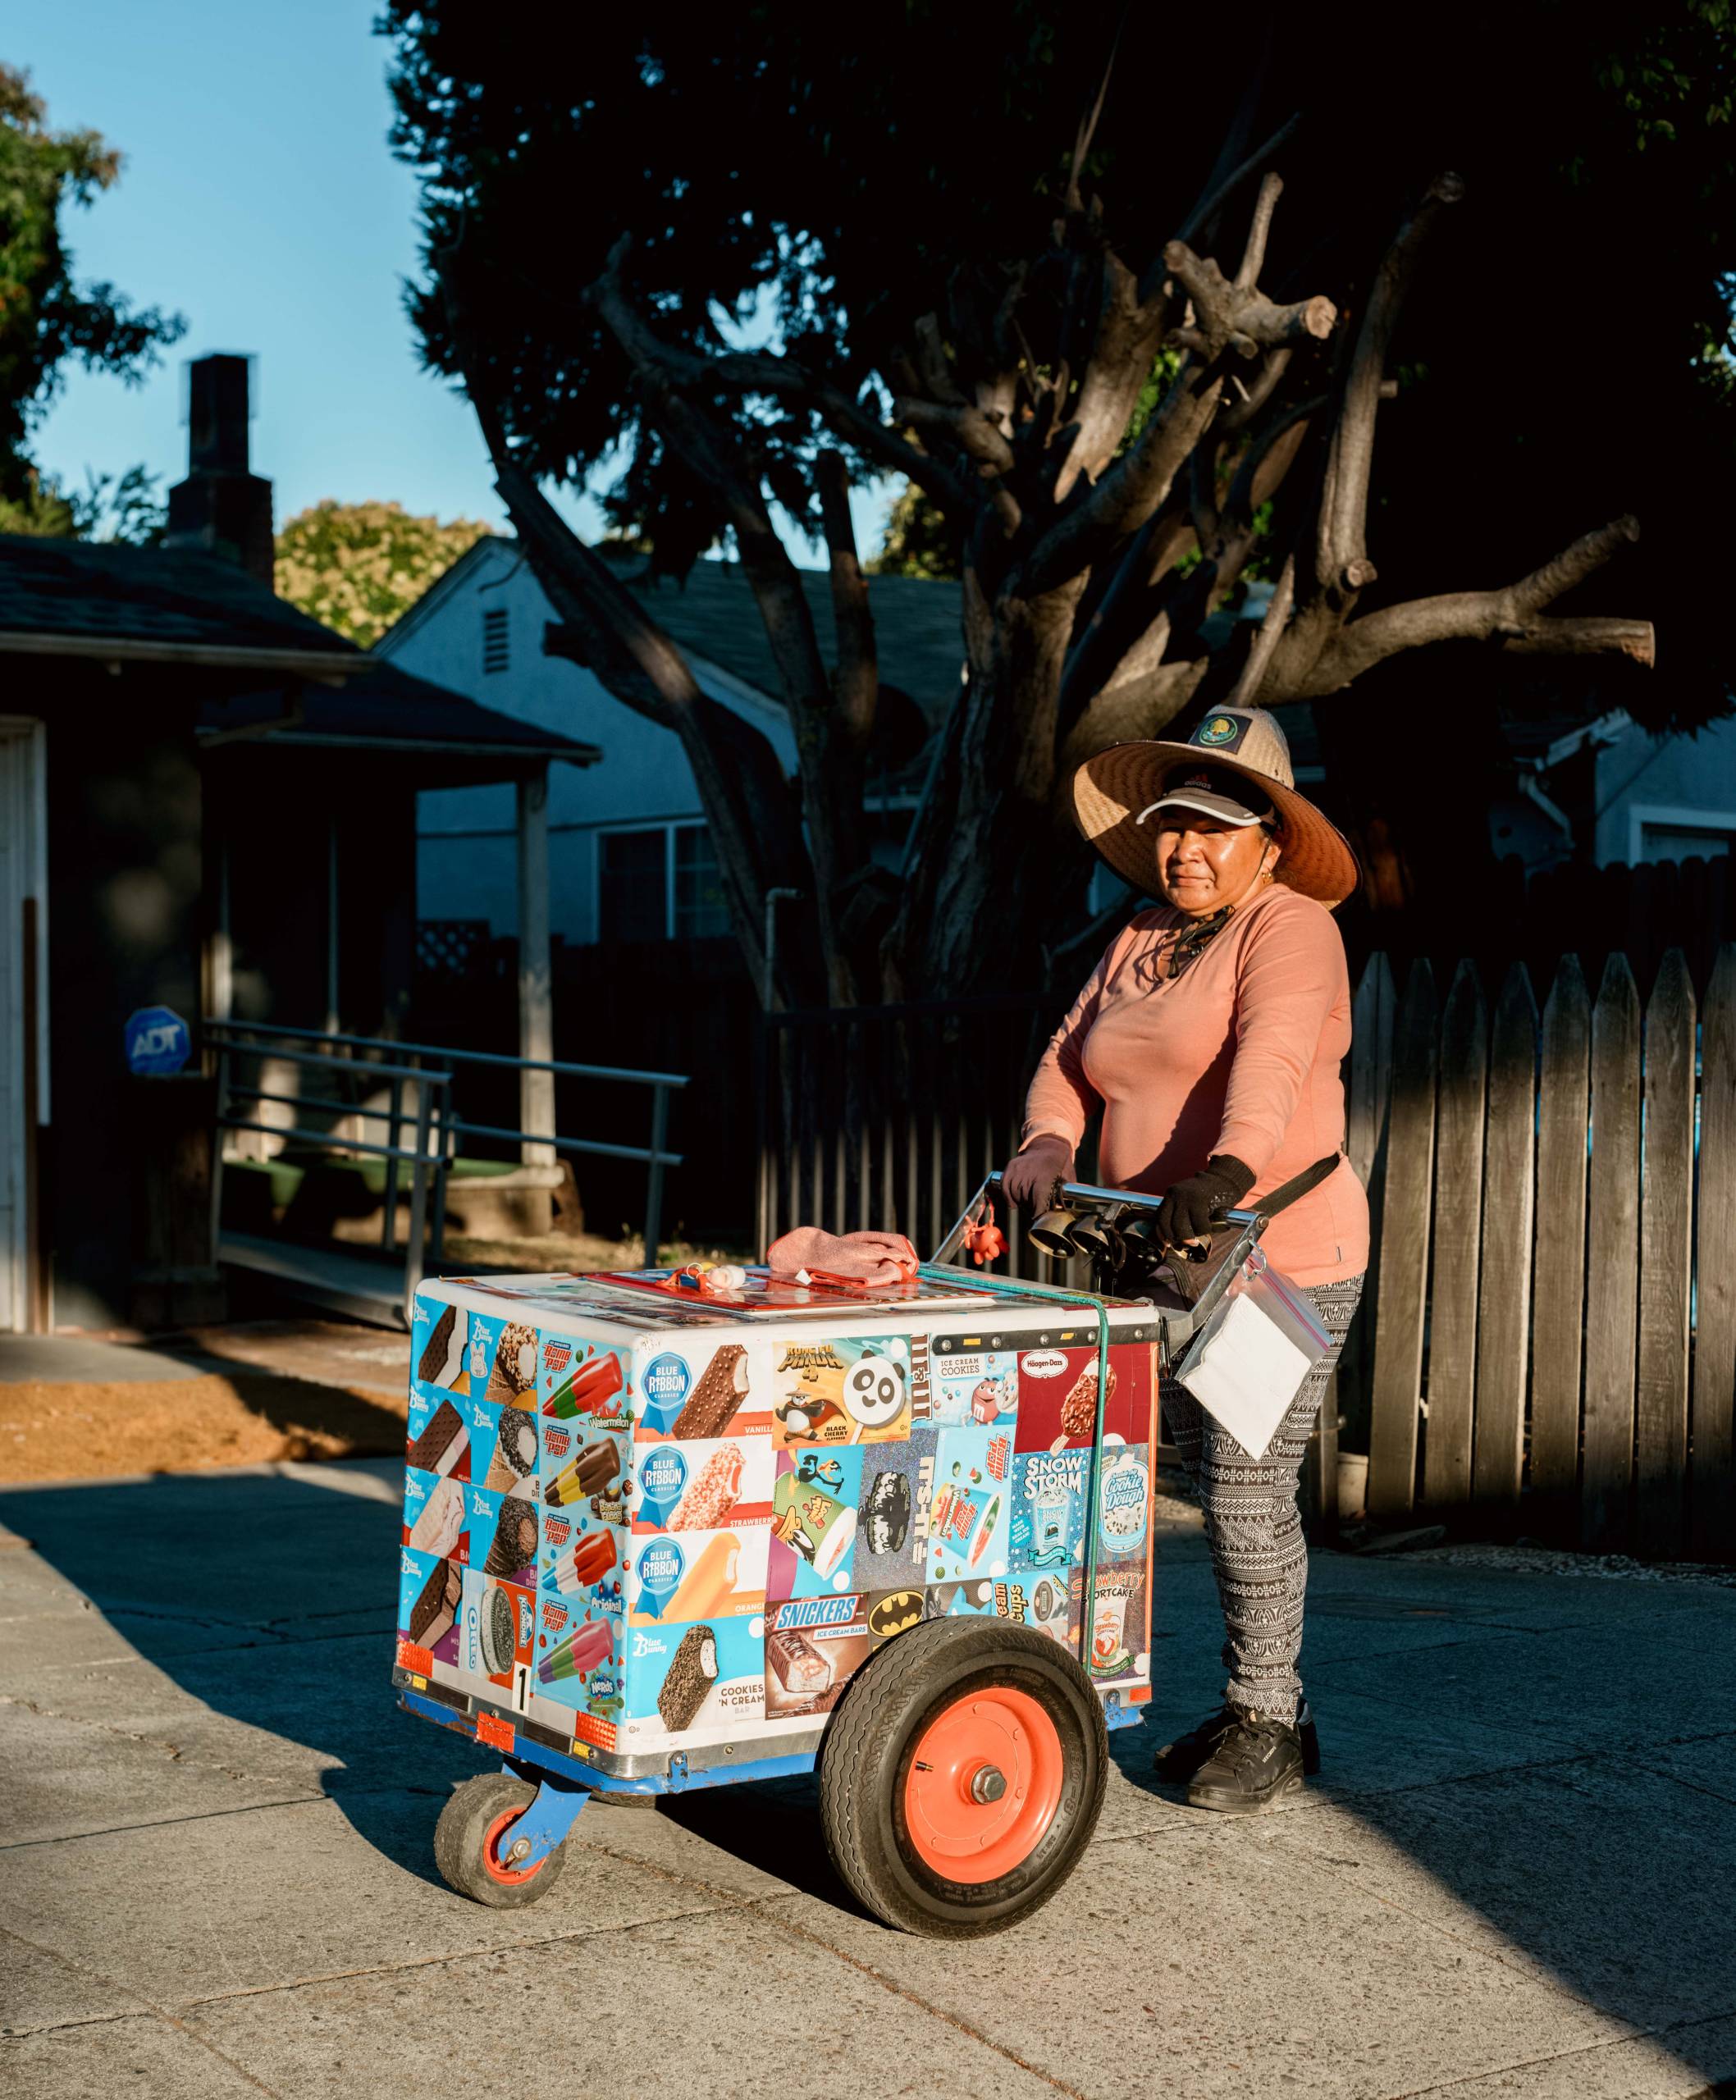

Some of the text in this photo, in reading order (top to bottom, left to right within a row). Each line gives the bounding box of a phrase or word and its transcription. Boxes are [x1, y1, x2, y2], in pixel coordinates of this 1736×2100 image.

[1184, 780, 1212, 790] adidas
[131, 1023, 181, 1058] ADT
[545, 1344, 572, 1362] BOMB
[787, 1344, 834, 1355] KUNG FU
[546, 1358, 567, 1372] POP
[778, 1354, 845, 1372] PANDA
[941, 1358, 979, 1367] ICE CREAM
[941, 1366, 980, 1376] COOKIES
[656, 1367, 678, 1376] BLUE
[802, 1365, 818, 1382] 4
[649, 1376, 685, 1393] RIBBON
[589, 1416, 629, 1429] Watermelon
[544, 1429, 571, 1446] BOMB
[547, 1442, 567, 1458] POP
[985, 1439, 998, 1476] POP
[993, 1434, 1007, 1483] BOMB
[653, 1459, 674, 1468] BLUE
[1026, 1456, 1083, 1477] SNOW
[646, 1468, 682, 1486] RIBBON
[1023, 1472, 1082, 1500] STORM
[1105, 1476, 1144, 1496] Cookie
[1105, 1489, 1145, 1510] Dough
[940, 1489, 961, 1536] Watermelon
[544, 1518, 571, 1535] BOMB
[546, 1531, 567, 1545] POP
[650, 1550, 672, 1560] BLUE
[643, 1559, 678, 1578] RIBBON
[542, 1603, 569, 1622] BOMB
[592, 1596, 622, 1613] Original
[779, 1596, 857, 1628] SNICKERS
[518, 1595, 528, 1648] KLONDIKE
[544, 1616, 564, 1632] POP
[1094, 1623, 1118, 1633] Strawberry
[468, 1607, 478, 1669] OREO
[817, 1626, 866, 1638] ICE CREAM BARS
[519, 1668, 527, 1711] 1
[720, 1684, 764, 1697] COOKIES
[719, 1696, 765, 1707] 'N CREAM
[734, 1706, 750, 1714] BAR
